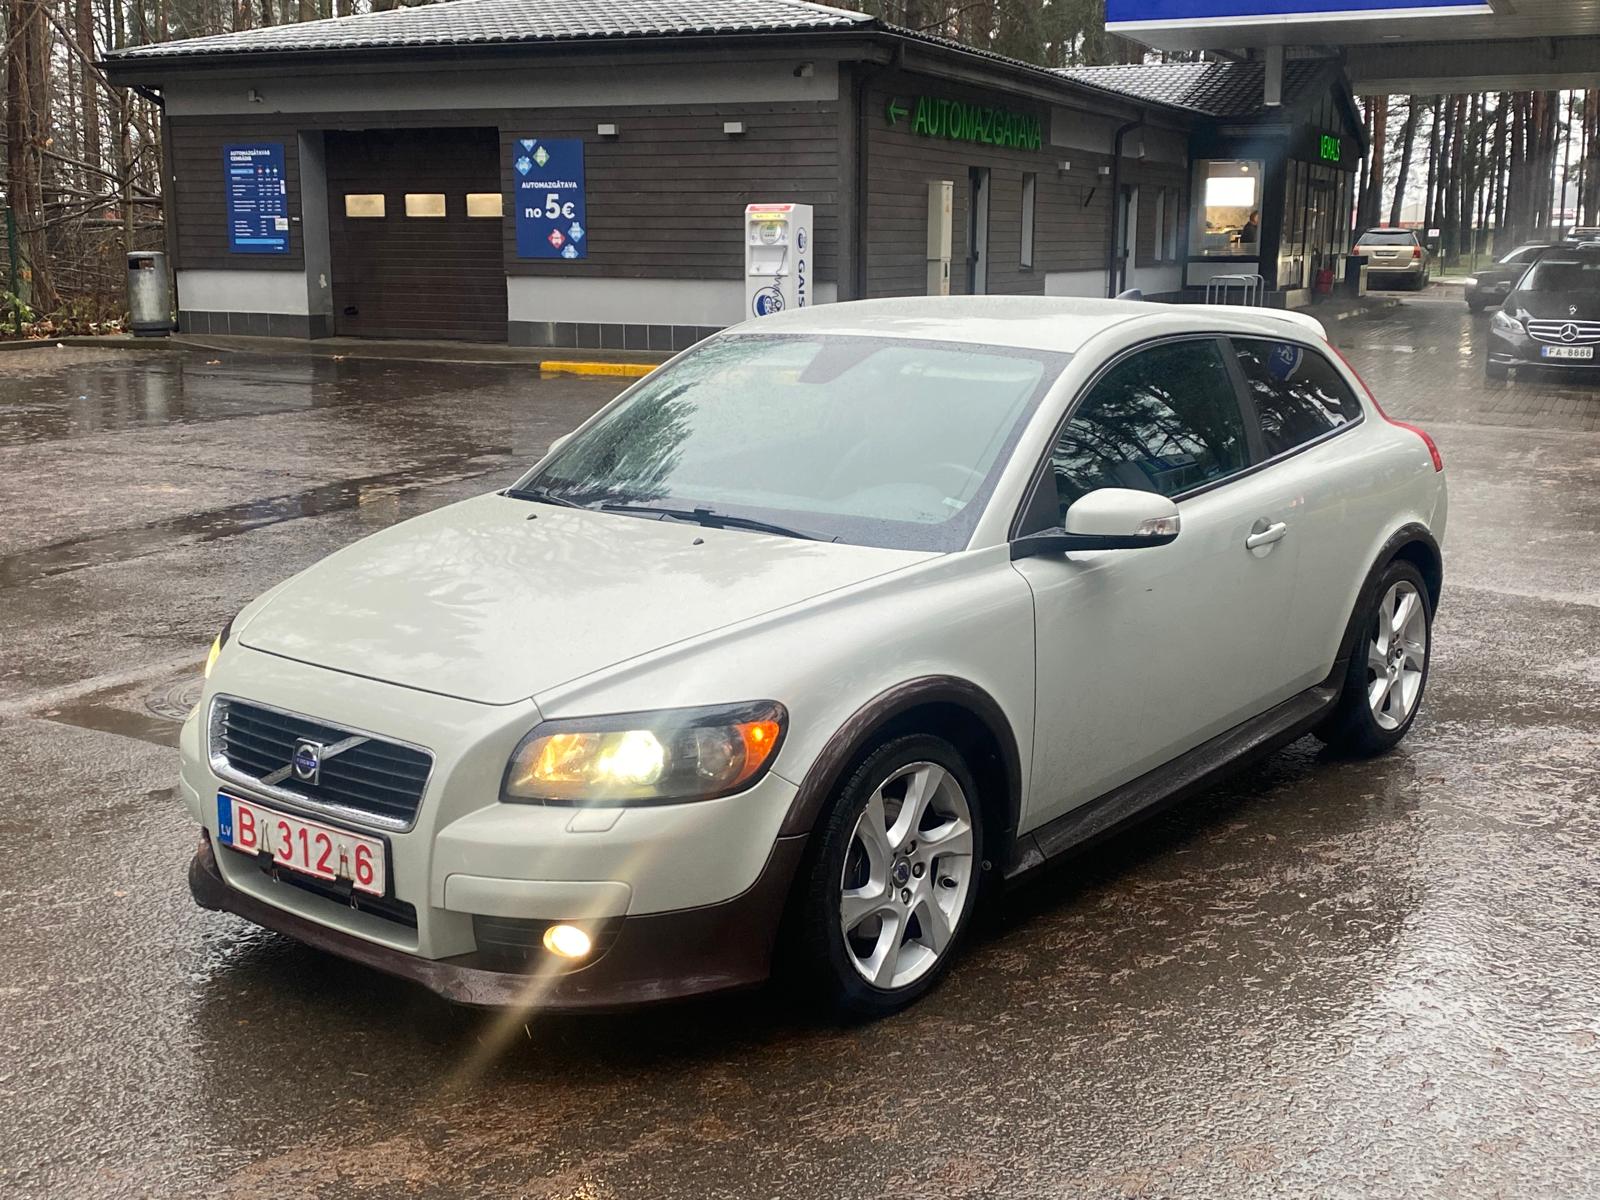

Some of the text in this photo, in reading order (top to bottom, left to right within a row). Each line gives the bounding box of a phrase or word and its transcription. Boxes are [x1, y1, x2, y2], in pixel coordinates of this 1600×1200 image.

[521, 180, 578, 189] AUTOMAZGĀTAVA
[525, 207, 542, 218] no
[220, 825, 232, 836] LV
